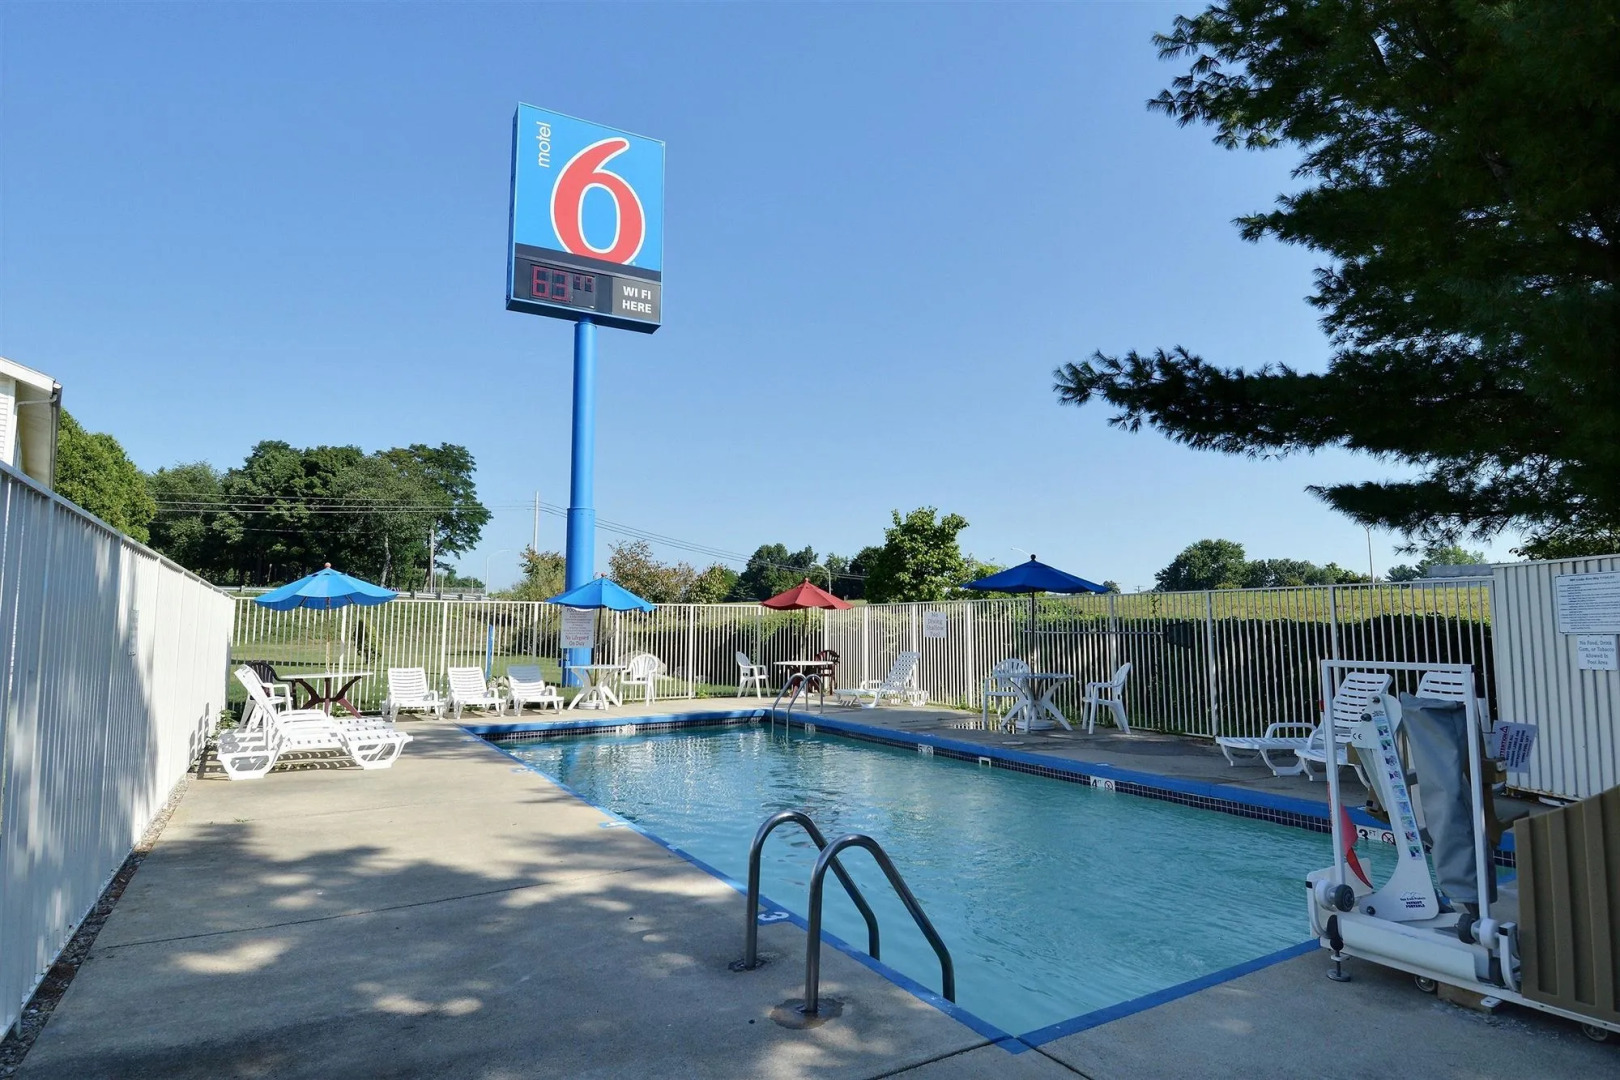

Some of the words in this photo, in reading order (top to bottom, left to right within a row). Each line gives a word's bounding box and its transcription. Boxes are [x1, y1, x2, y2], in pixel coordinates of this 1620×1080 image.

[536, 121, 551, 168] motel
[550, 136, 646, 265] 6
[623, 285, 638, 298] WI
[641, 289, 651, 300] FI
[622, 300, 652, 314] HERE
[1092, 779, 1098, 787] 4
[1358, 829, 1368, 840] 3
[758, 912, 790, 921] 3
